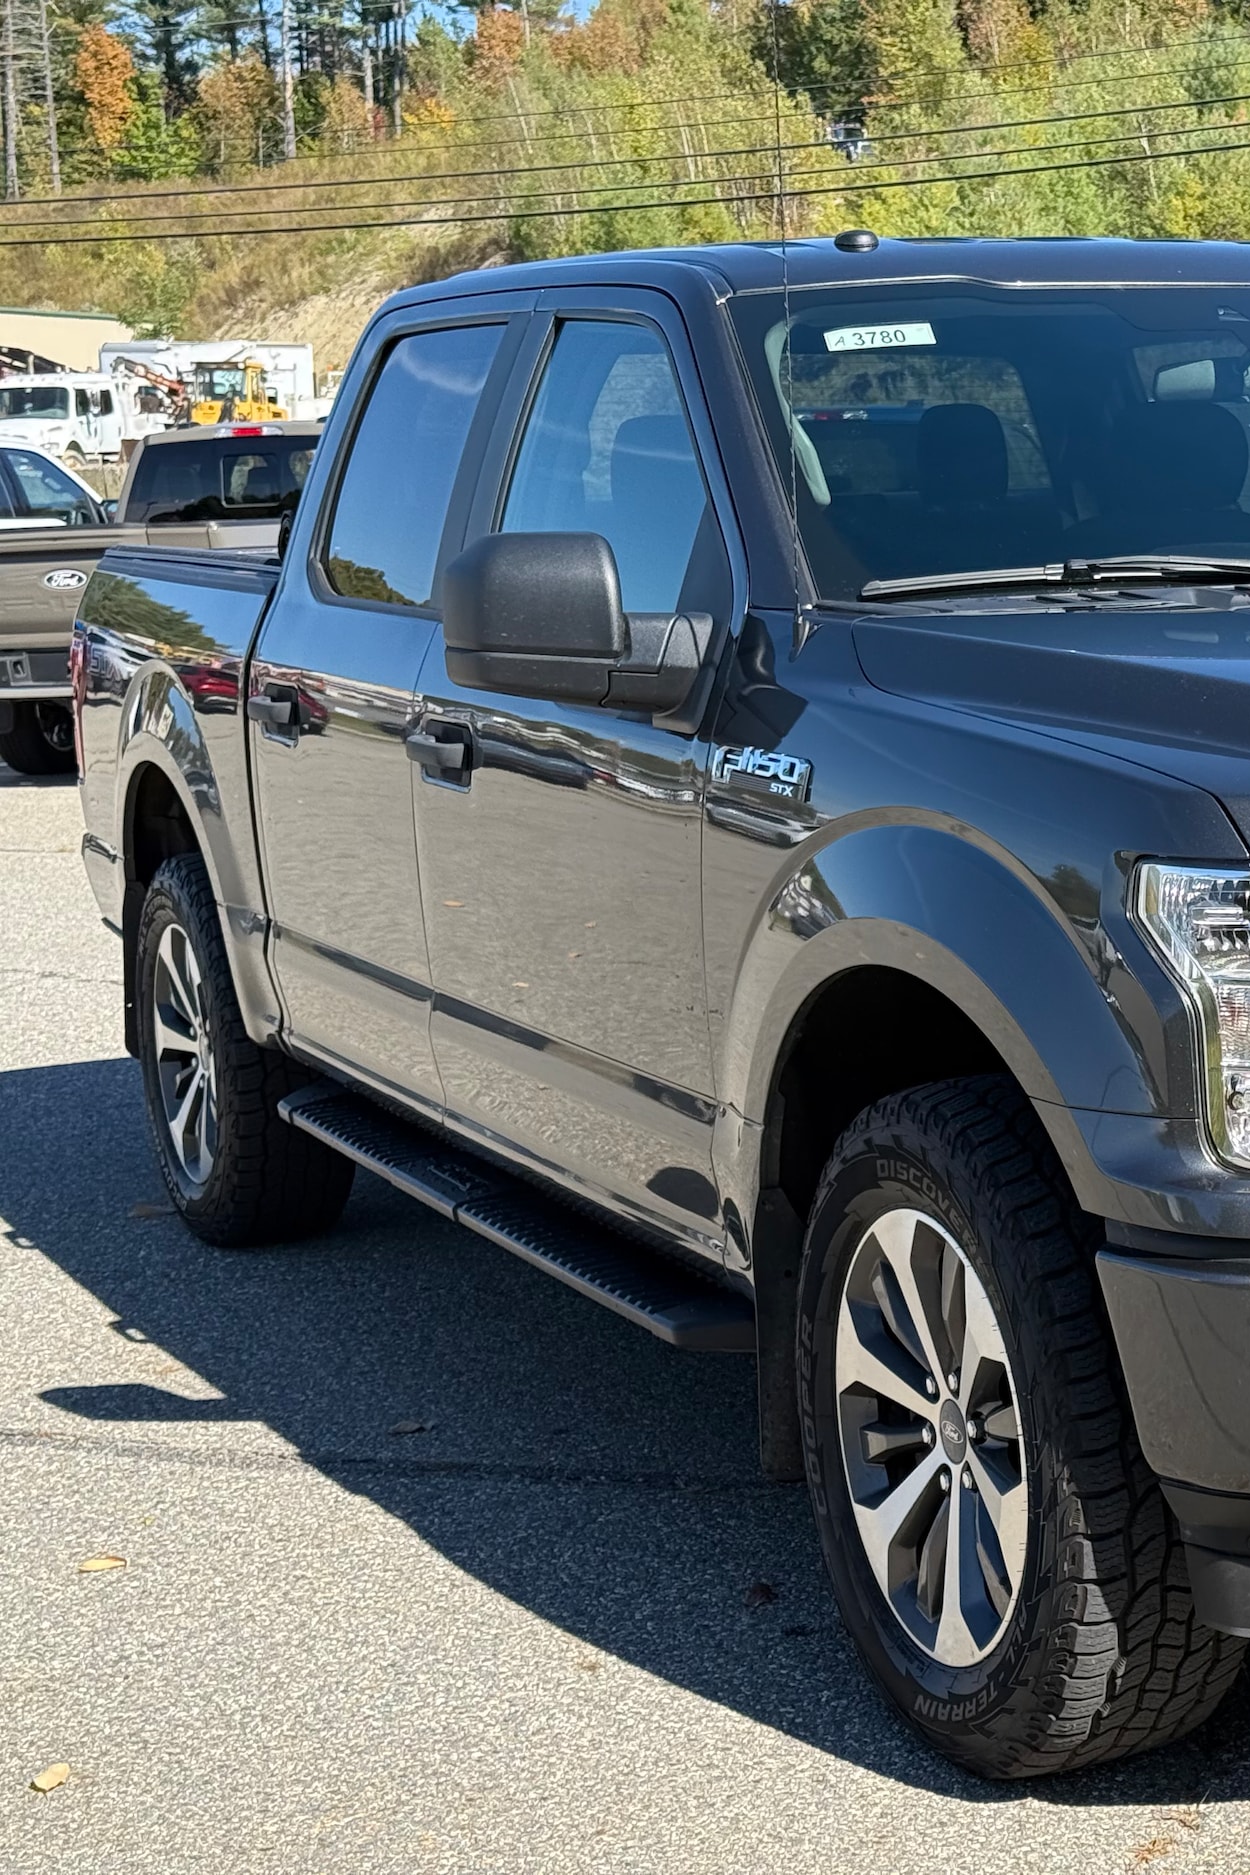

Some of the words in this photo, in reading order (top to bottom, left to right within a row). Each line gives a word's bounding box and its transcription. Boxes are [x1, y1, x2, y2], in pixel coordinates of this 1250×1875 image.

[851, 329, 907, 346] 3780
[769, 783, 794, 797] STX
[799, 1313, 828, 1515] COOPER
